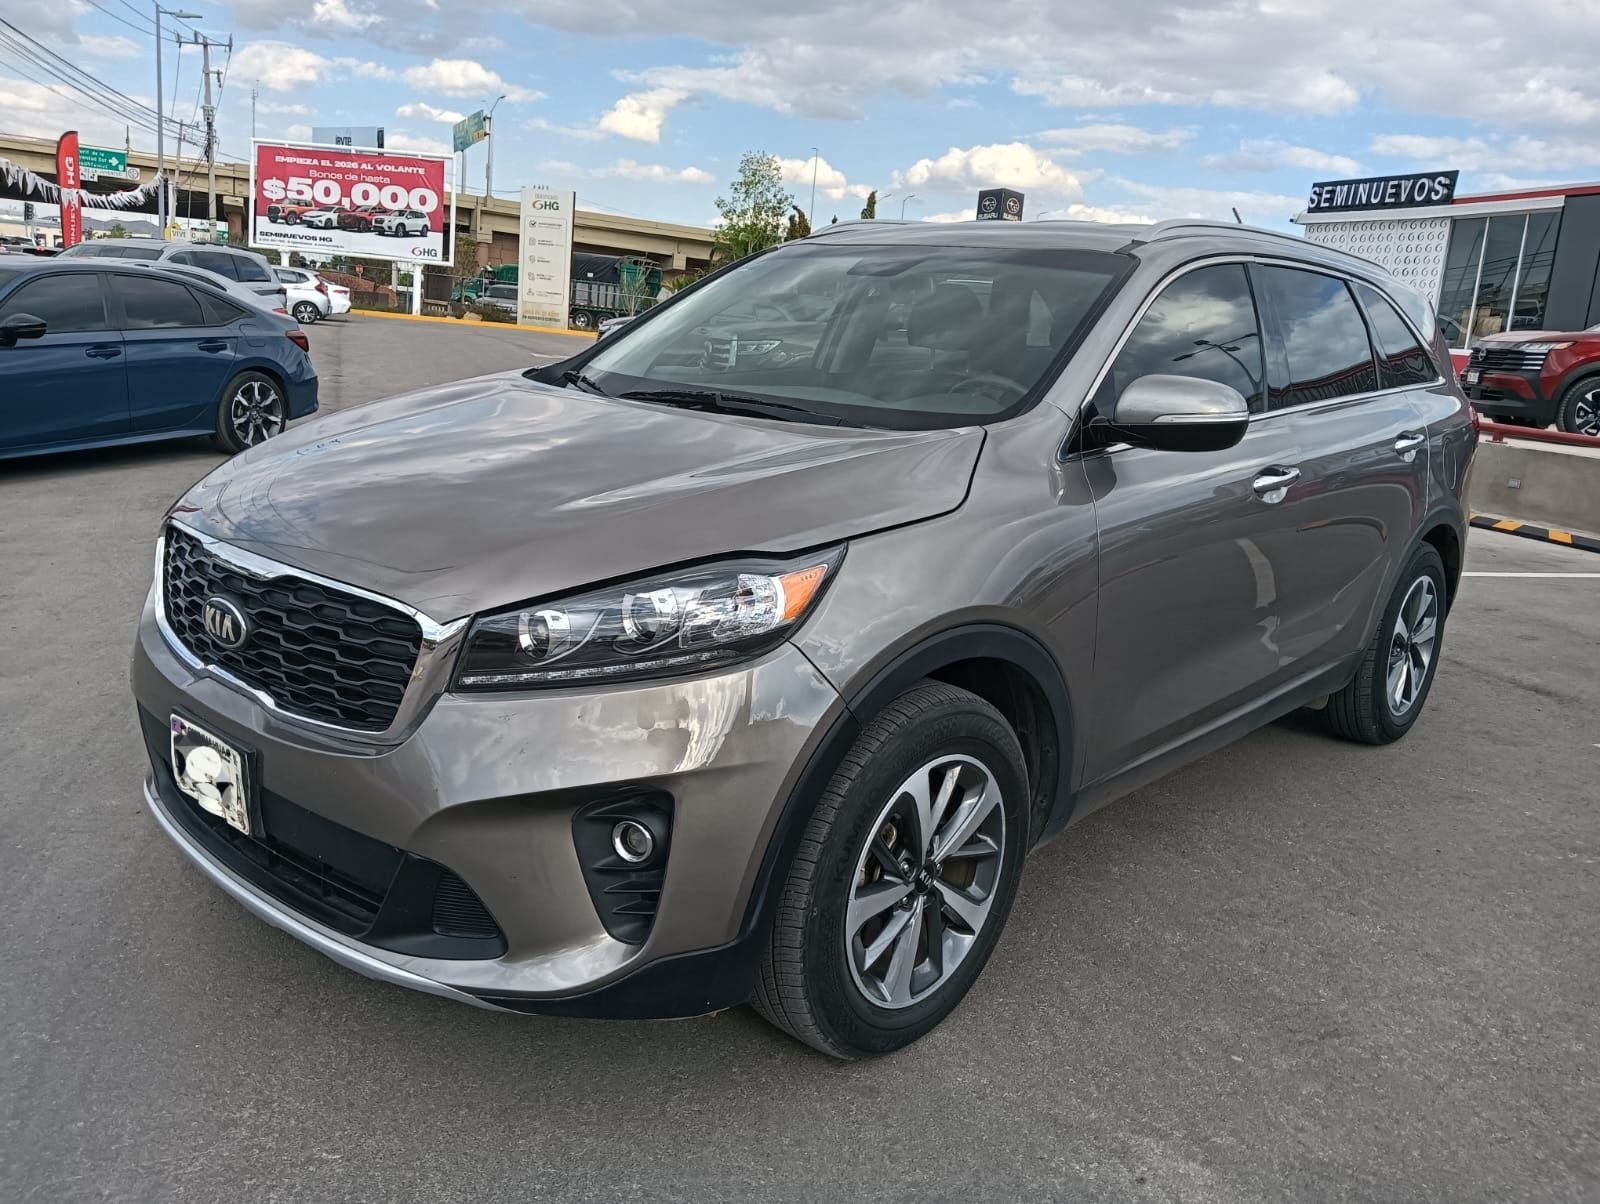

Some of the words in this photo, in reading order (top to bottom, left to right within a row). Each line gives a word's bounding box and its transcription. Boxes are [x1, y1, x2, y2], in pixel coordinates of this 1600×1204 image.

[65, 156, 75, 185] HG
[275, 155, 319, 166] EMPIEZA
[320, 159, 333, 167] EL
[334, 160, 359, 169] 2026
[375, 164, 425, 175] VOLANTE
[309, 169, 343, 180] Bonos
[344, 171, 358, 181] de
[360, 172, 391, 184] hasta
[262, 176, 438, 214] $50,000
[1309, 176, 1450, 209] SEMINUEVOS
[544, 200, 560, 211] HG
[977, 212, 999, 220] SUBARU
[259, 231, 317, 242] SEMINUEVOS
[422, 247, 438, 258] HG
[206, 604, 236, 642] KIA
